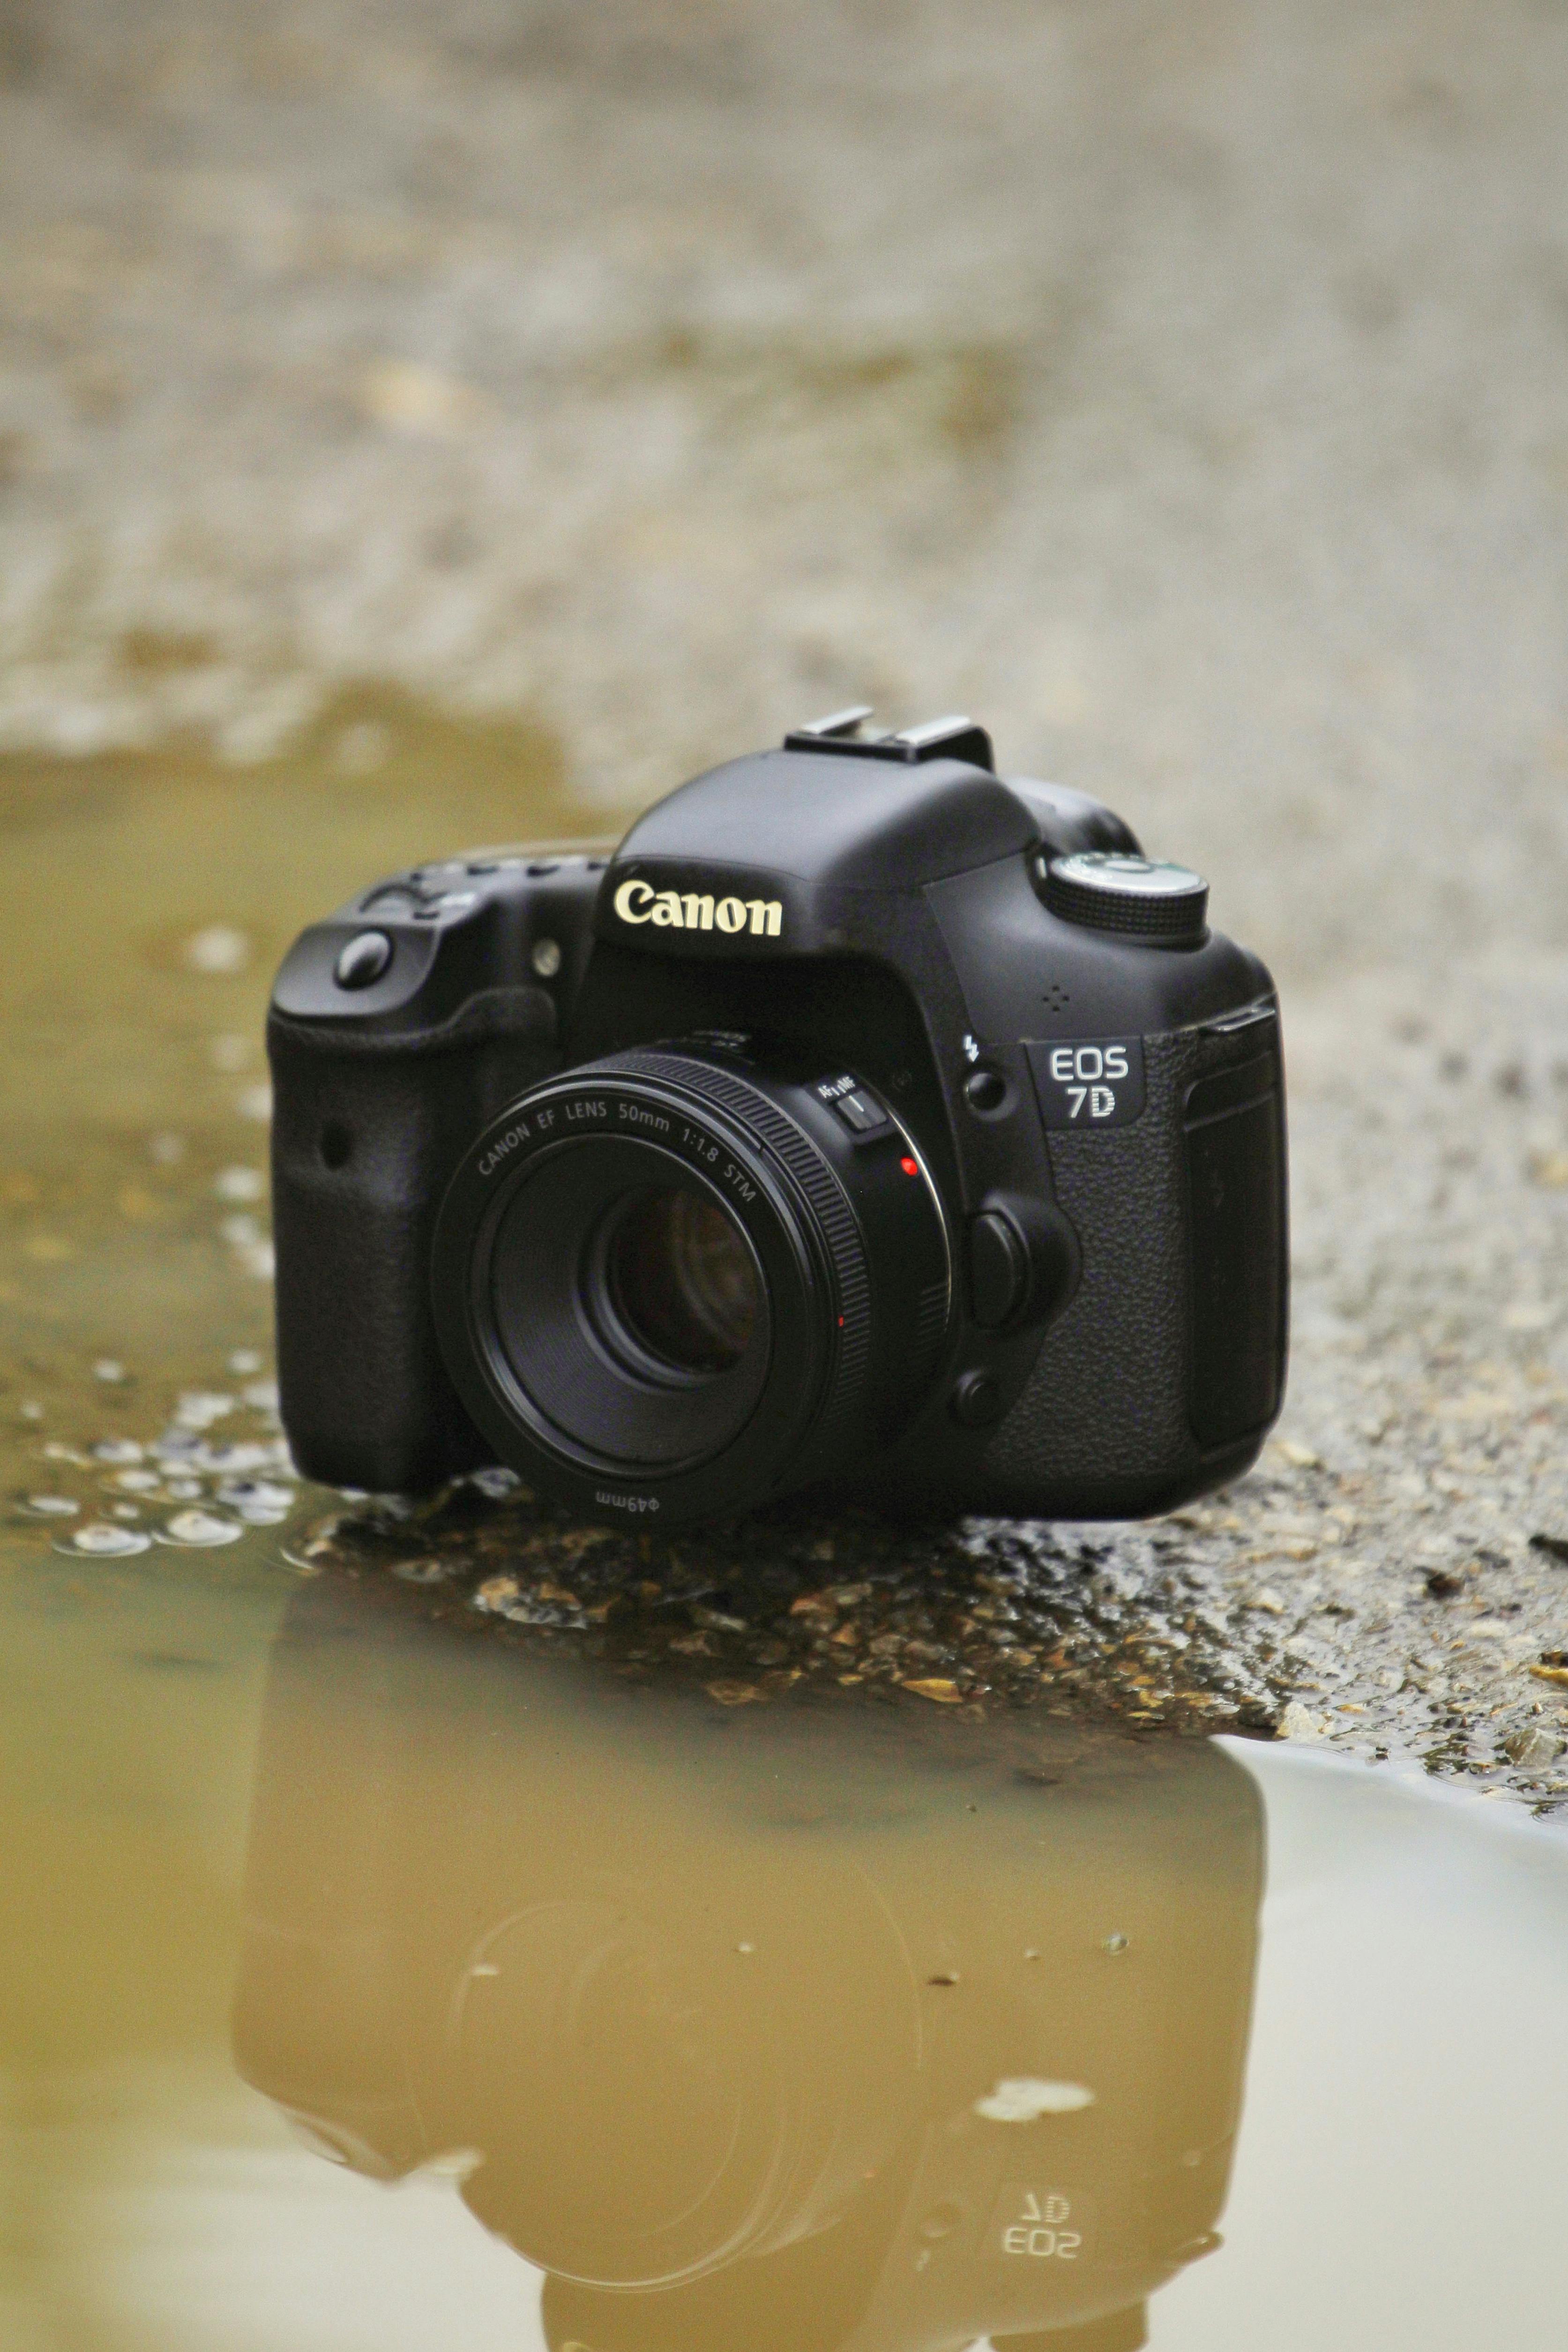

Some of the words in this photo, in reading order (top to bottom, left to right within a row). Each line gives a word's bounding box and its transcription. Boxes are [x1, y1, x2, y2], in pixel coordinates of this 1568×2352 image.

[614, 879, 783, 936] Canon
[1050, 1046, 1128, 1081] EOS
[1066, 1086, 1115, 1118] 7D
[478, 1123, 530, 1175] CANON
[537, 1110, 556, 1129] EF
[566, 1101, 607, 1121] LENS
[619, 1103, 671, 1132] 50mm
[682, 1127, 719, 1162] 1:1.8
[724, 1164, 756, 1202] STM
